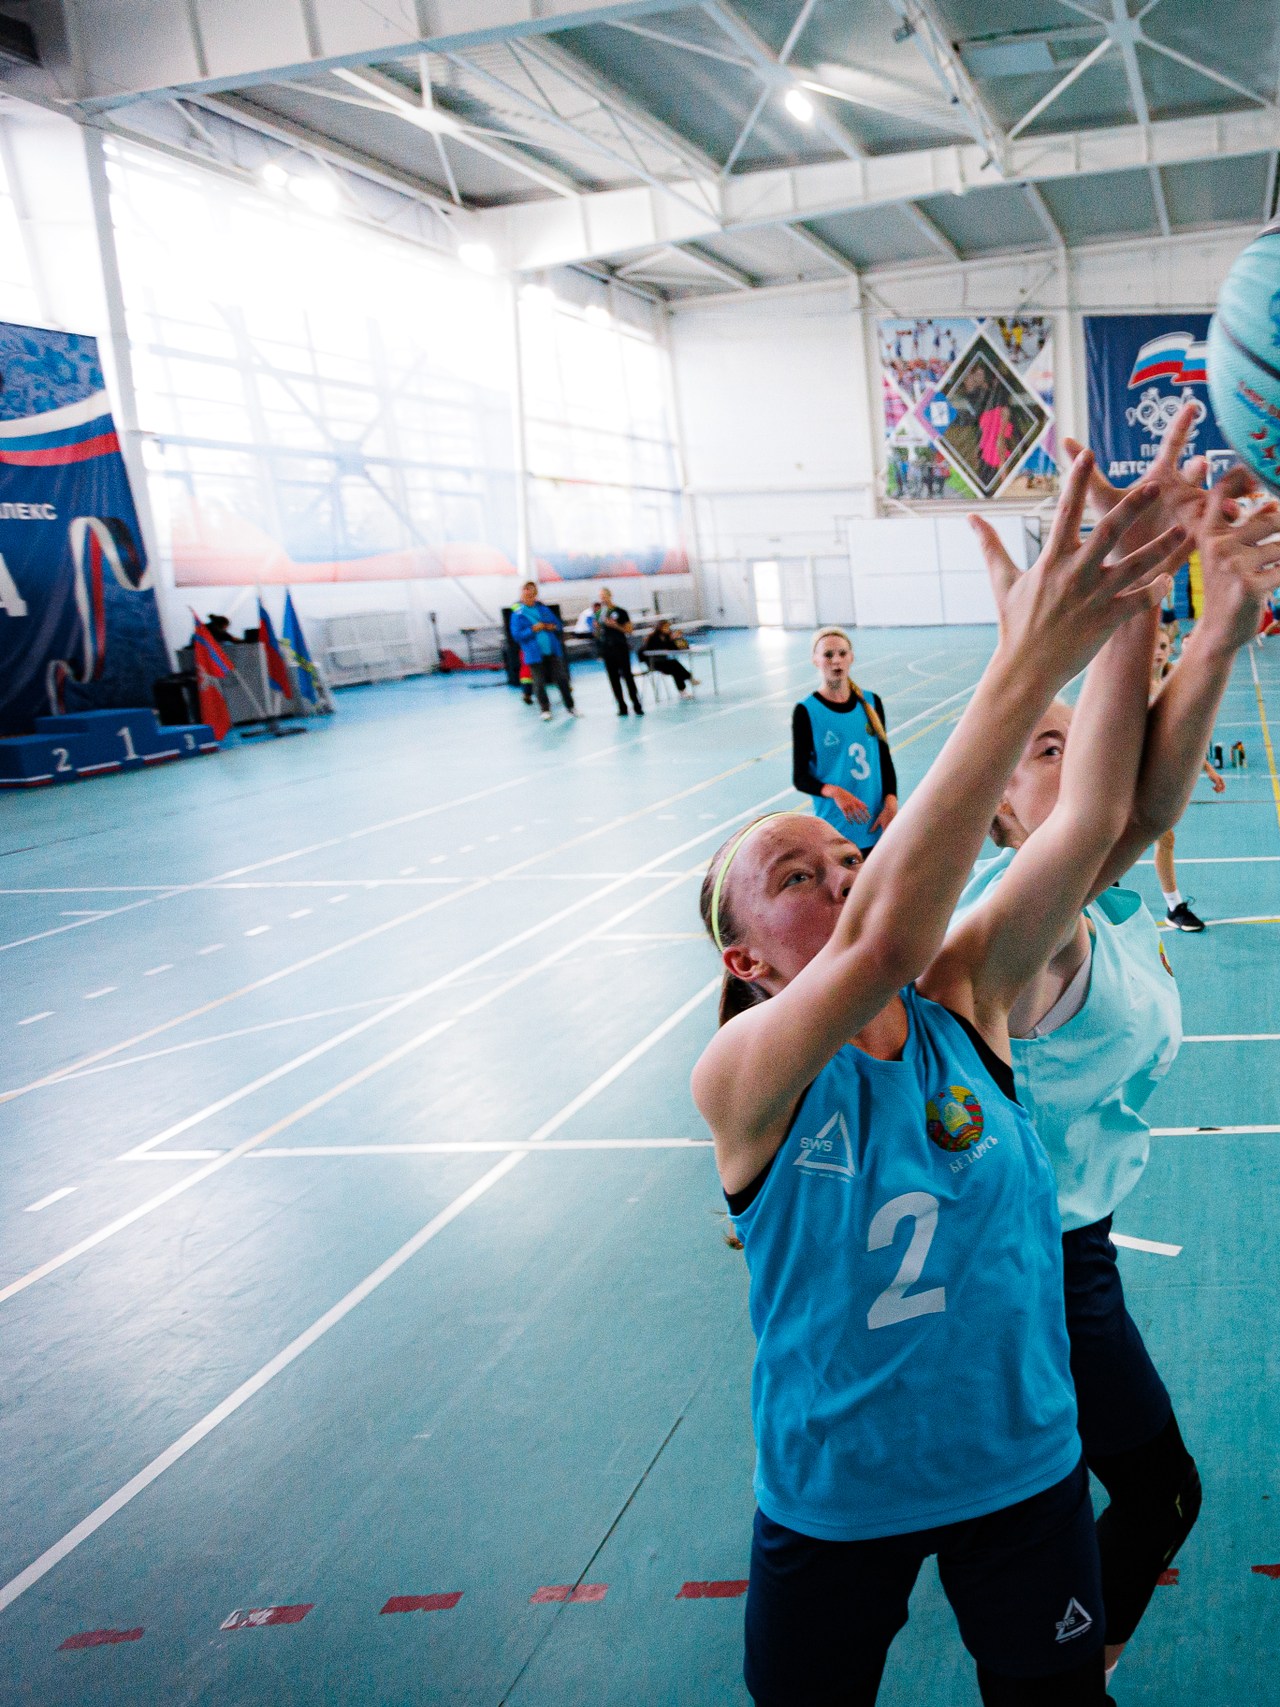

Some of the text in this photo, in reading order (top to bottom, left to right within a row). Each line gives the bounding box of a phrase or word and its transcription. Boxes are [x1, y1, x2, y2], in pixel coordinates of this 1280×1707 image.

[52, 747, 73, 773] 2
[116, 726, 139, 761] 1
[848, 742, 871, 781] 3
[800, 1137, 833, 1152] SWS
[867, 1191, 946, 1330] 2
